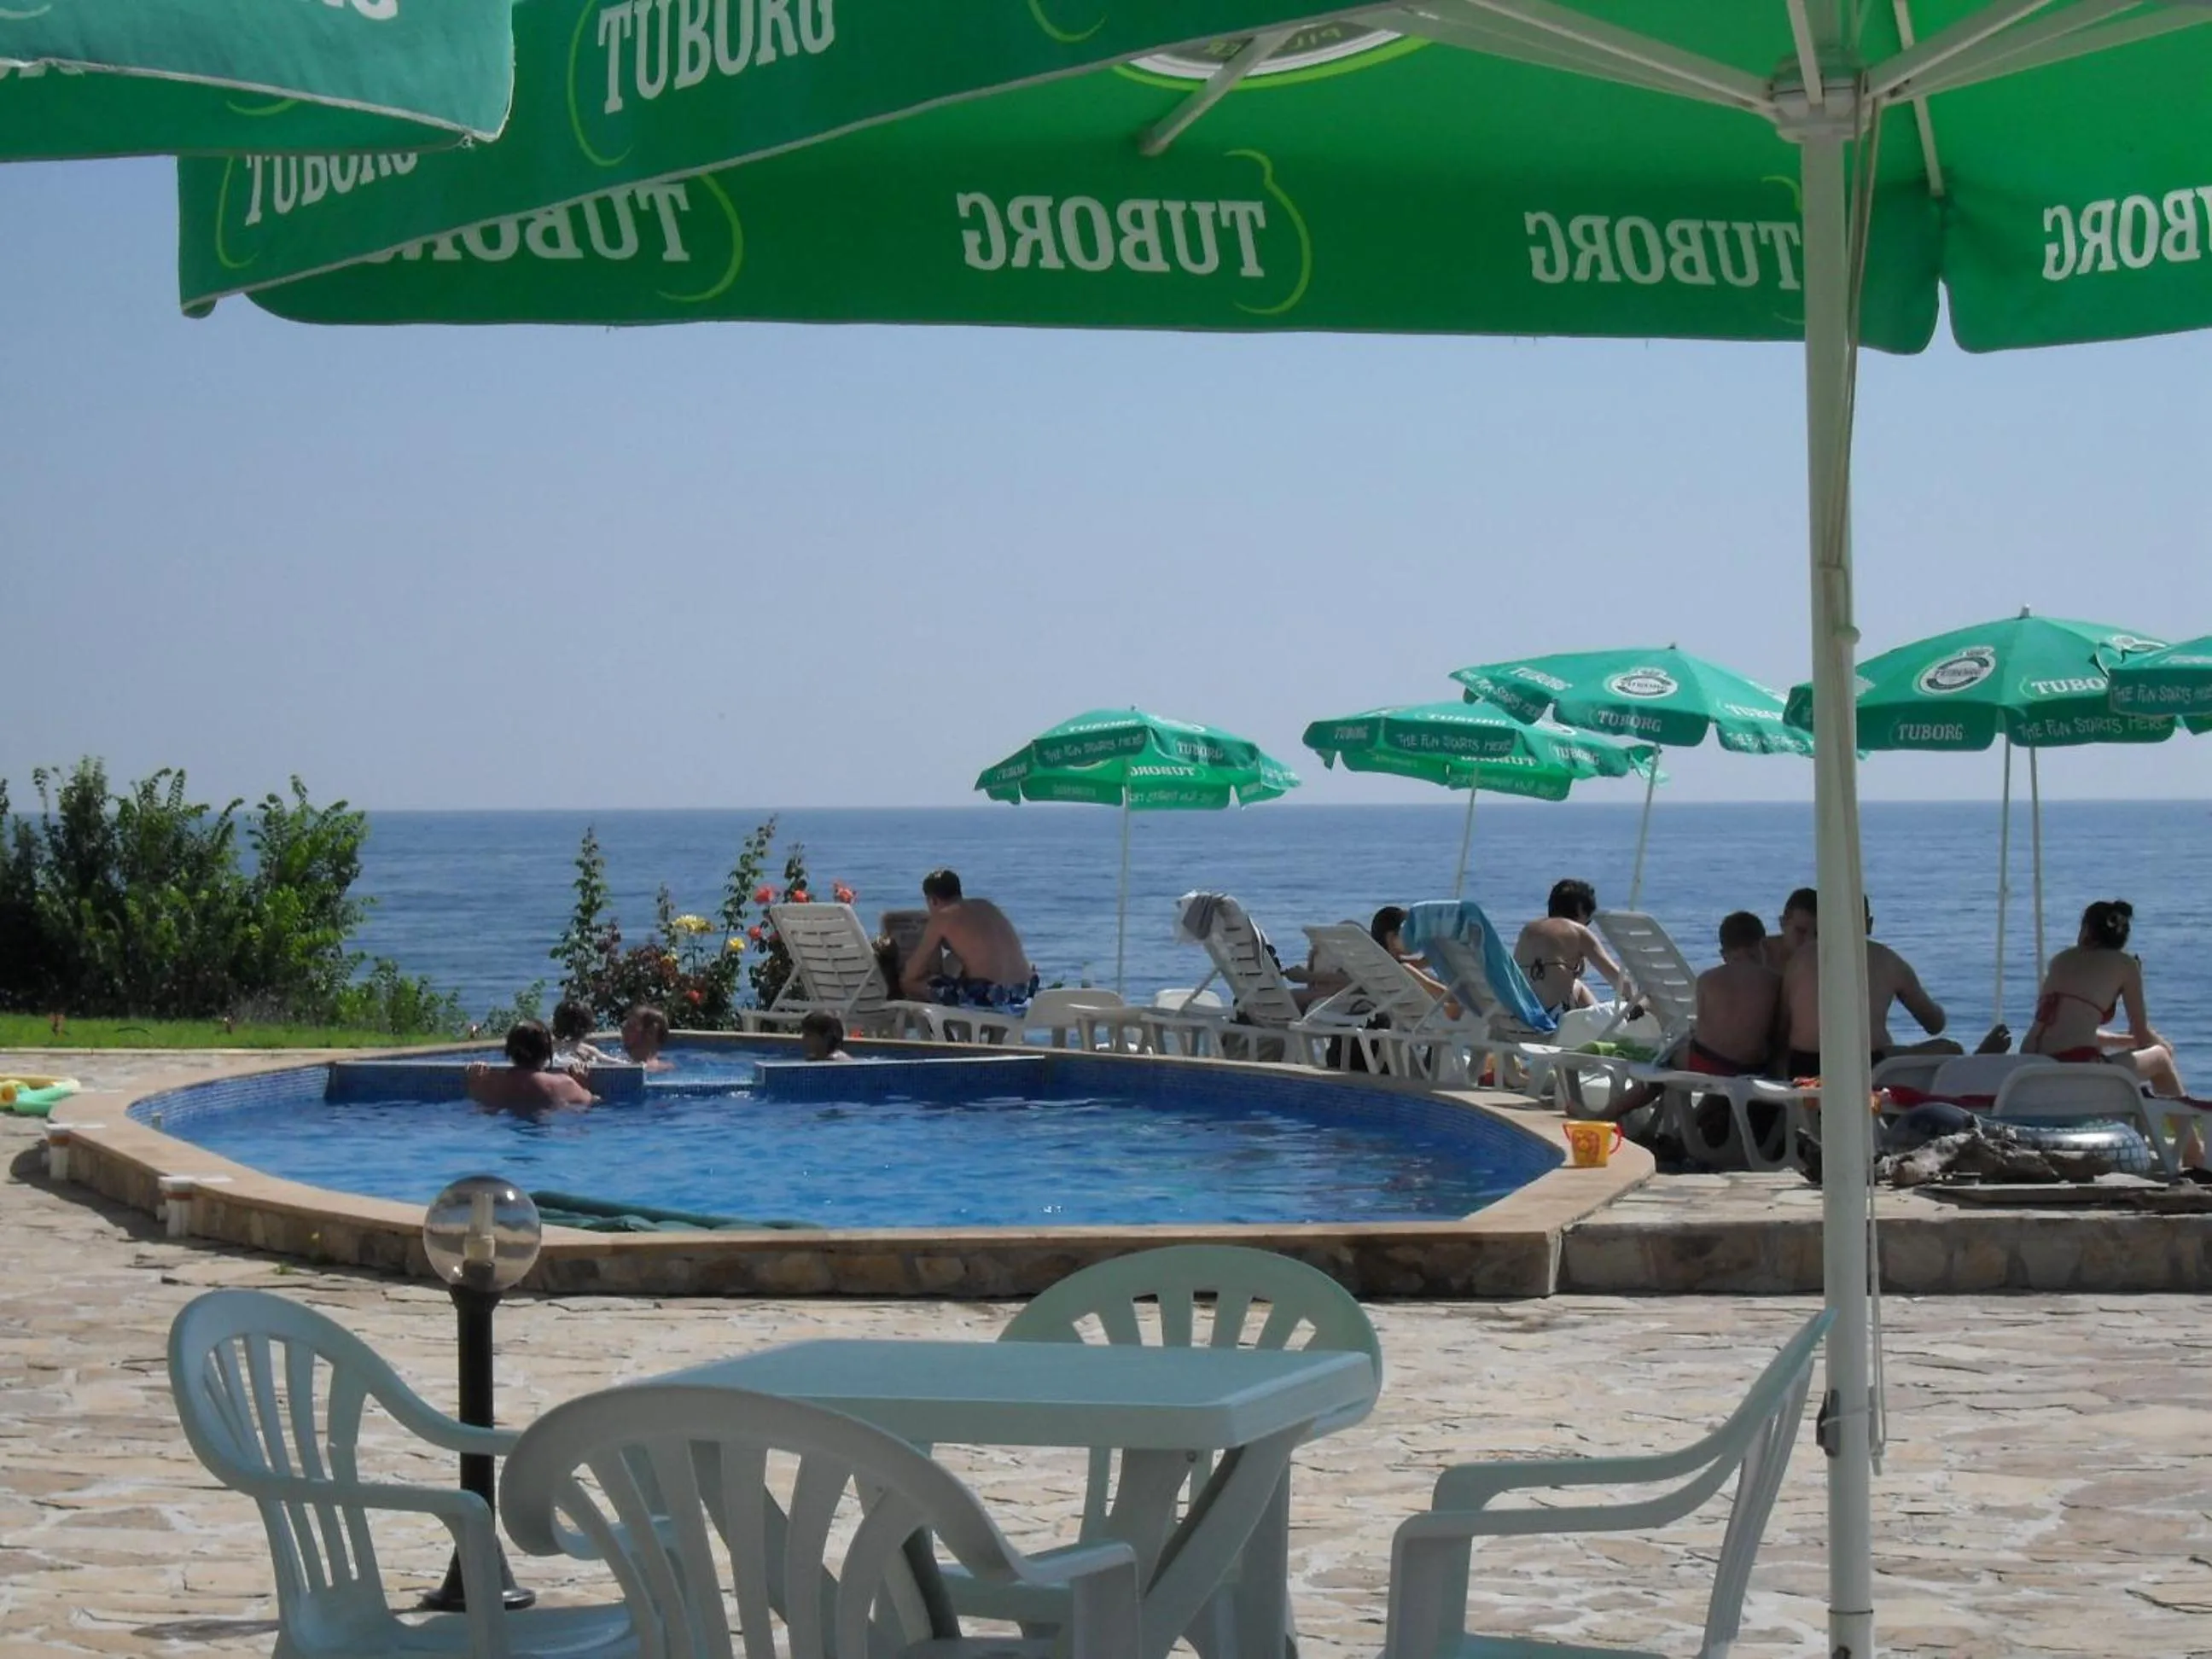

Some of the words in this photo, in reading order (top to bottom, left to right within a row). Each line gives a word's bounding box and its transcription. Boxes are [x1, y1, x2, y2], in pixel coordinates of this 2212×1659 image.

[2030, 676, 2109, 695] TUBO
[1598, 709, 1662, 732] TUBORG
[1898, 723, 1964, 741] TUBORG
